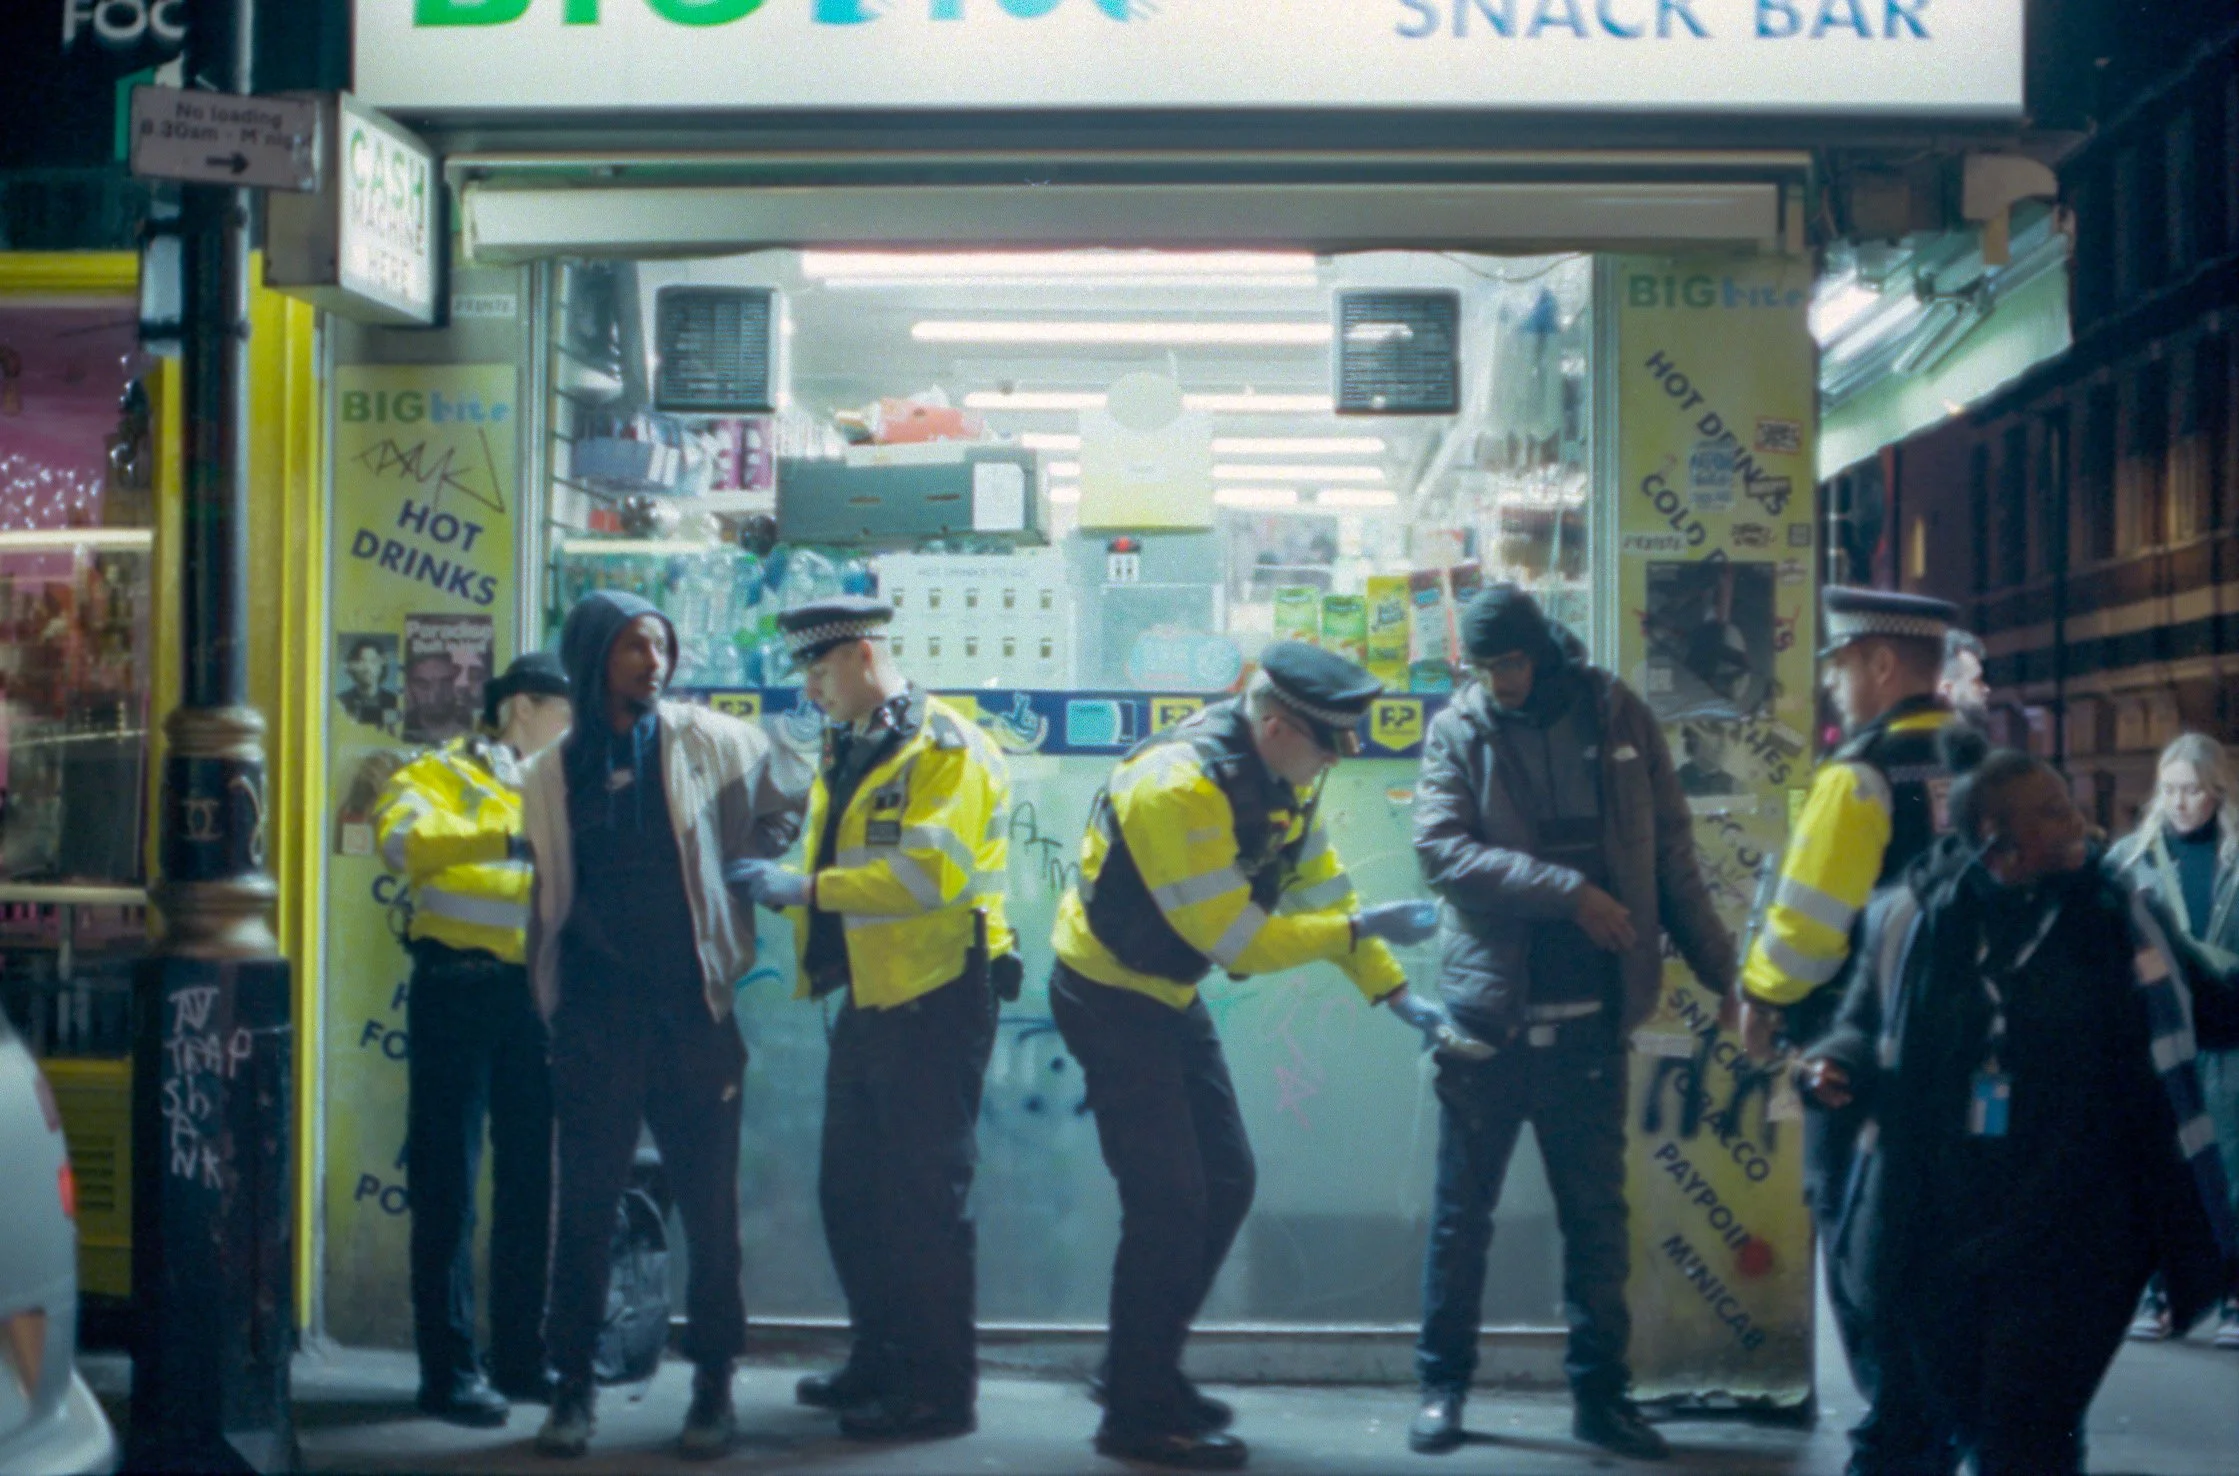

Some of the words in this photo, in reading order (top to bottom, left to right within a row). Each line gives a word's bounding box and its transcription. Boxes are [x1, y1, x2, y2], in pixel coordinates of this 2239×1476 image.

[1395, 0, 1713, 39] SNACK
[1754, 0, 1933, 39] BAR
[175, 101, 204, 121] No
[210, 104, 282, 130] loading
[350, 126, 426, 222] CASH
[1627, 274, 1716, 309] BIG
[342, 390, 425, 423] BIG
[1643, 350, 1705, 412] HOT
[396, 499, 484, 552] HOT
[1639, 472, 1707, 547] COLD
[350, 527, 498, 607] DRINKS
[1661, 1233, 1767, 1352] MINICAB
